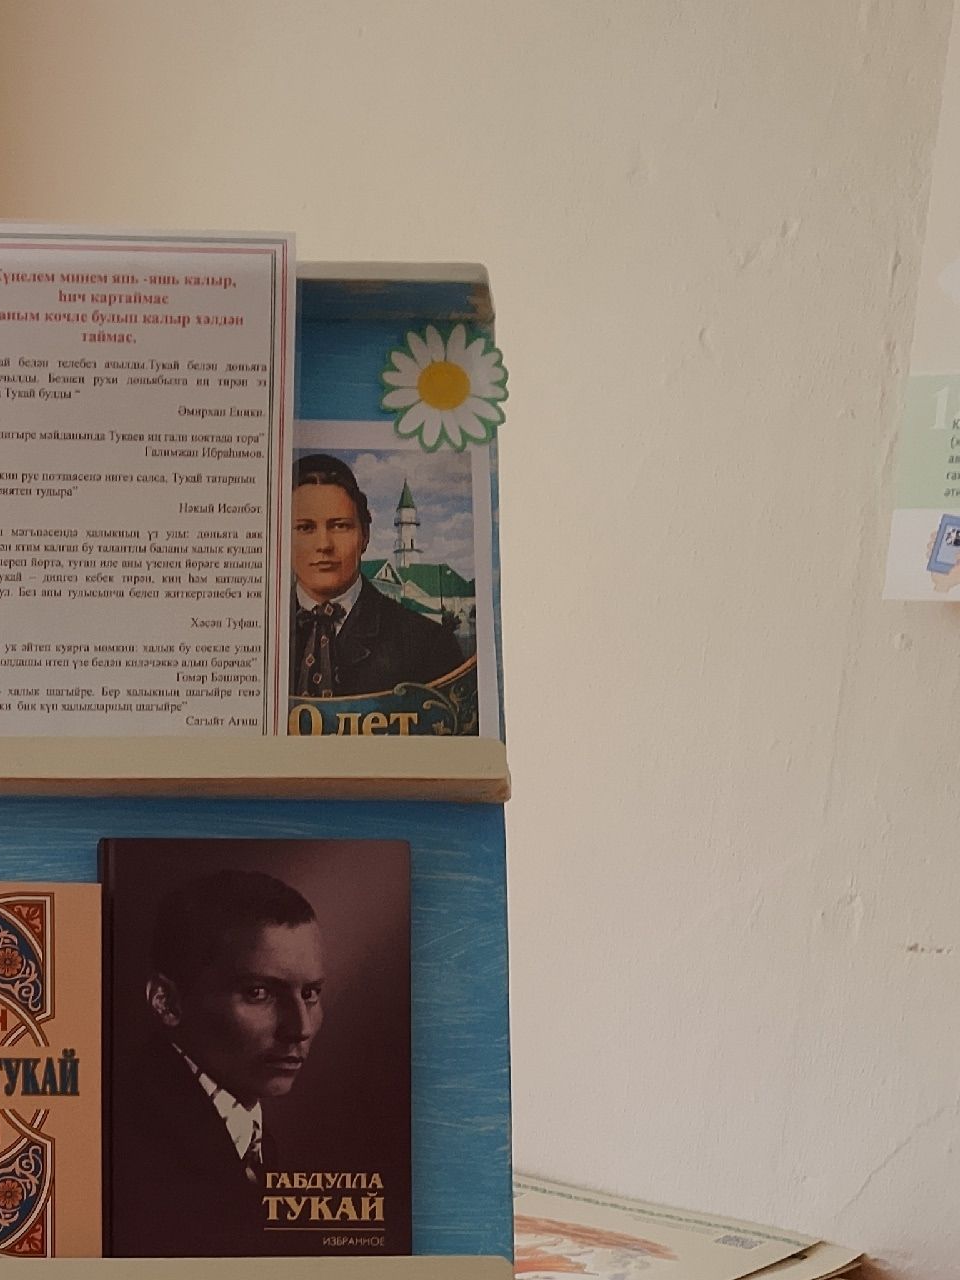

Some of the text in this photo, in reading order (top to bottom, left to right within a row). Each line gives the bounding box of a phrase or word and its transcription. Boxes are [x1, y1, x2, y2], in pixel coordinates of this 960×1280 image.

[330, 710, 418, 736] лет
[265, 1172, 384, 1191] ГАБДУЛЛА
[262, 1191, 385, 1221] ТУКАЙ
[323, 1236, 385, 1246] ИЗБРАННОЕ
